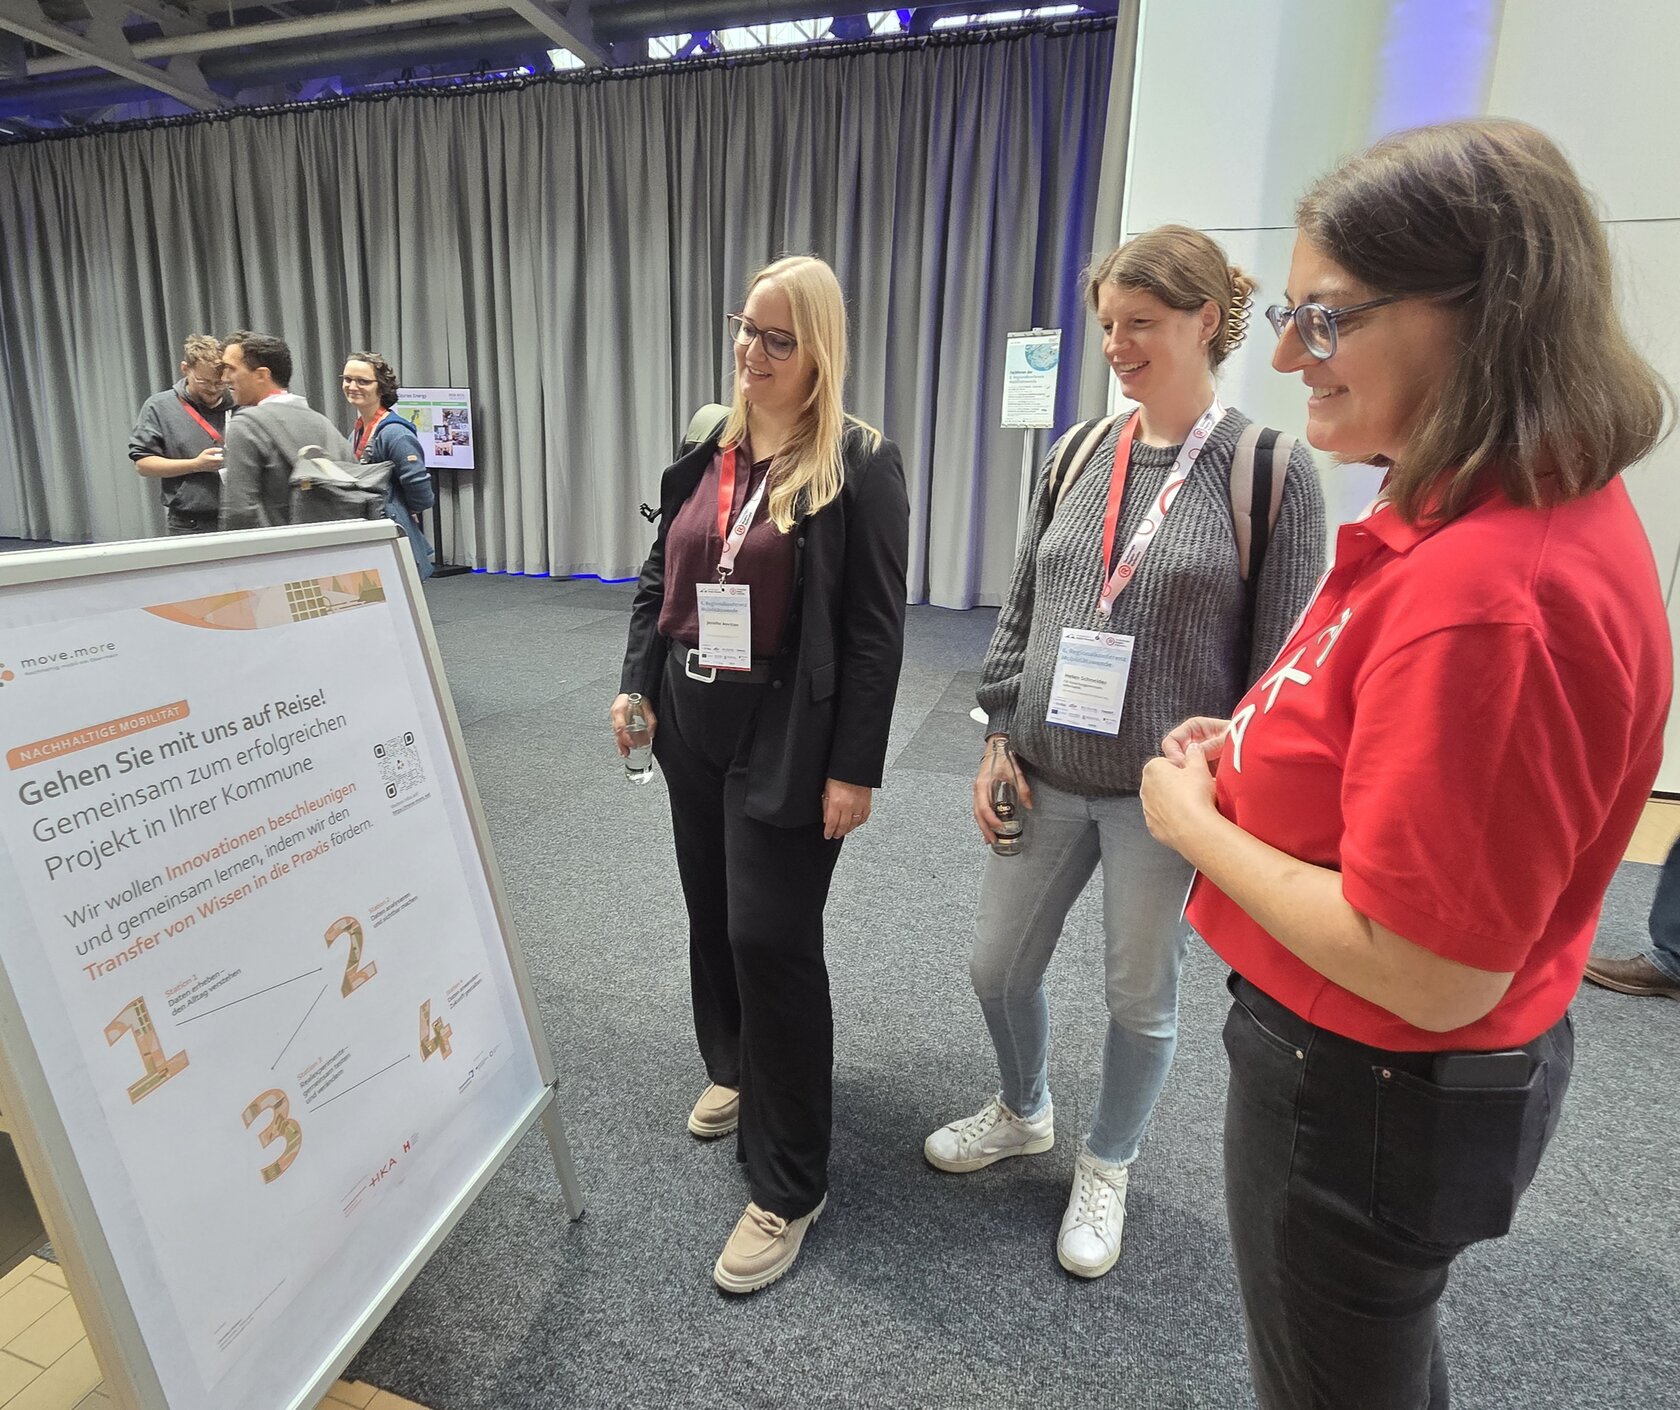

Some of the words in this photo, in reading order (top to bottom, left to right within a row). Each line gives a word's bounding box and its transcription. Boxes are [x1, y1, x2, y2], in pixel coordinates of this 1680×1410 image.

[20, 641, 116, 669] move.more
[18, 763, 111, 806] Gehen
[115, 747, 154, 774] Sie
[158, 731, 198, 760] mit
[201, 721, 238, 744] uns
[242, 704, 272, 731] auf
[274, 688, 327, 719] Reise!
[20, 725, 117, 762] NACHHALTIGE
[119, 706, 180, 732] MOBILITÄT
[32, 775, 183, 842] Gemeinsam
[187, 757, 232, 785] zum
[236, 714, 347, 766] erfolgreichen
[44, 827, 141, 881] Projekt
[143, 818, 167, 839] in
[169, 796, 217, 828] Ihrer
[221, 757, 314, 805] Kommune
[64, 903, 100, 928] Wir
[105, 875, 163, 910] wollen
[165, 825, 266, 881] Innovationen
[268, 782, 356, 831] beschleunigen
[75, 924, 113, 956] und
[117, 878, 213, 940] gemeinsam
[214, 853, 264, 884] lernen,
[264, 830, 306, 857] indem
[306, 818, 326, 836] wir
[328, 807, 351, 826] den
[82, 932, 161, 981] Transfer
[164, 914, 196, 938] von
[197, 882, 252, 919] Wissen
[253, 875, 268, 890] in
[270, 862, 290, 880] die
[291, 840, 330, 868] Praxis
[330, 819, 374, 848] fördern.
[370, 908, 386, 921] Daten
[164, 977, 192, 998] Station
[192, 974, 198, 982] 1
[324, 915, 378, 998] 2
[167, 990, 192, 1008] Daten
[192, 970, 220, 993] erheben
[171, 1004, 187, 1017] den
[187, 990, 209, 1008] Alltag
[208, 968, 242, 992] verstehen
[103, 995, 190, 1105] 1
[419, 998, 453, 1063] 4
[297, 1061, 318, 1080] Station
[303, 1067, 334, 1098] gemeinsam
[334, 1053, 351, 1070] testen
[305, 1091, 318, 1104] und
[317, 1069, 344, 1094] verändern
[241, 1088, 303, 1184] 3
[369, 1157, 397, 1188] HKA
